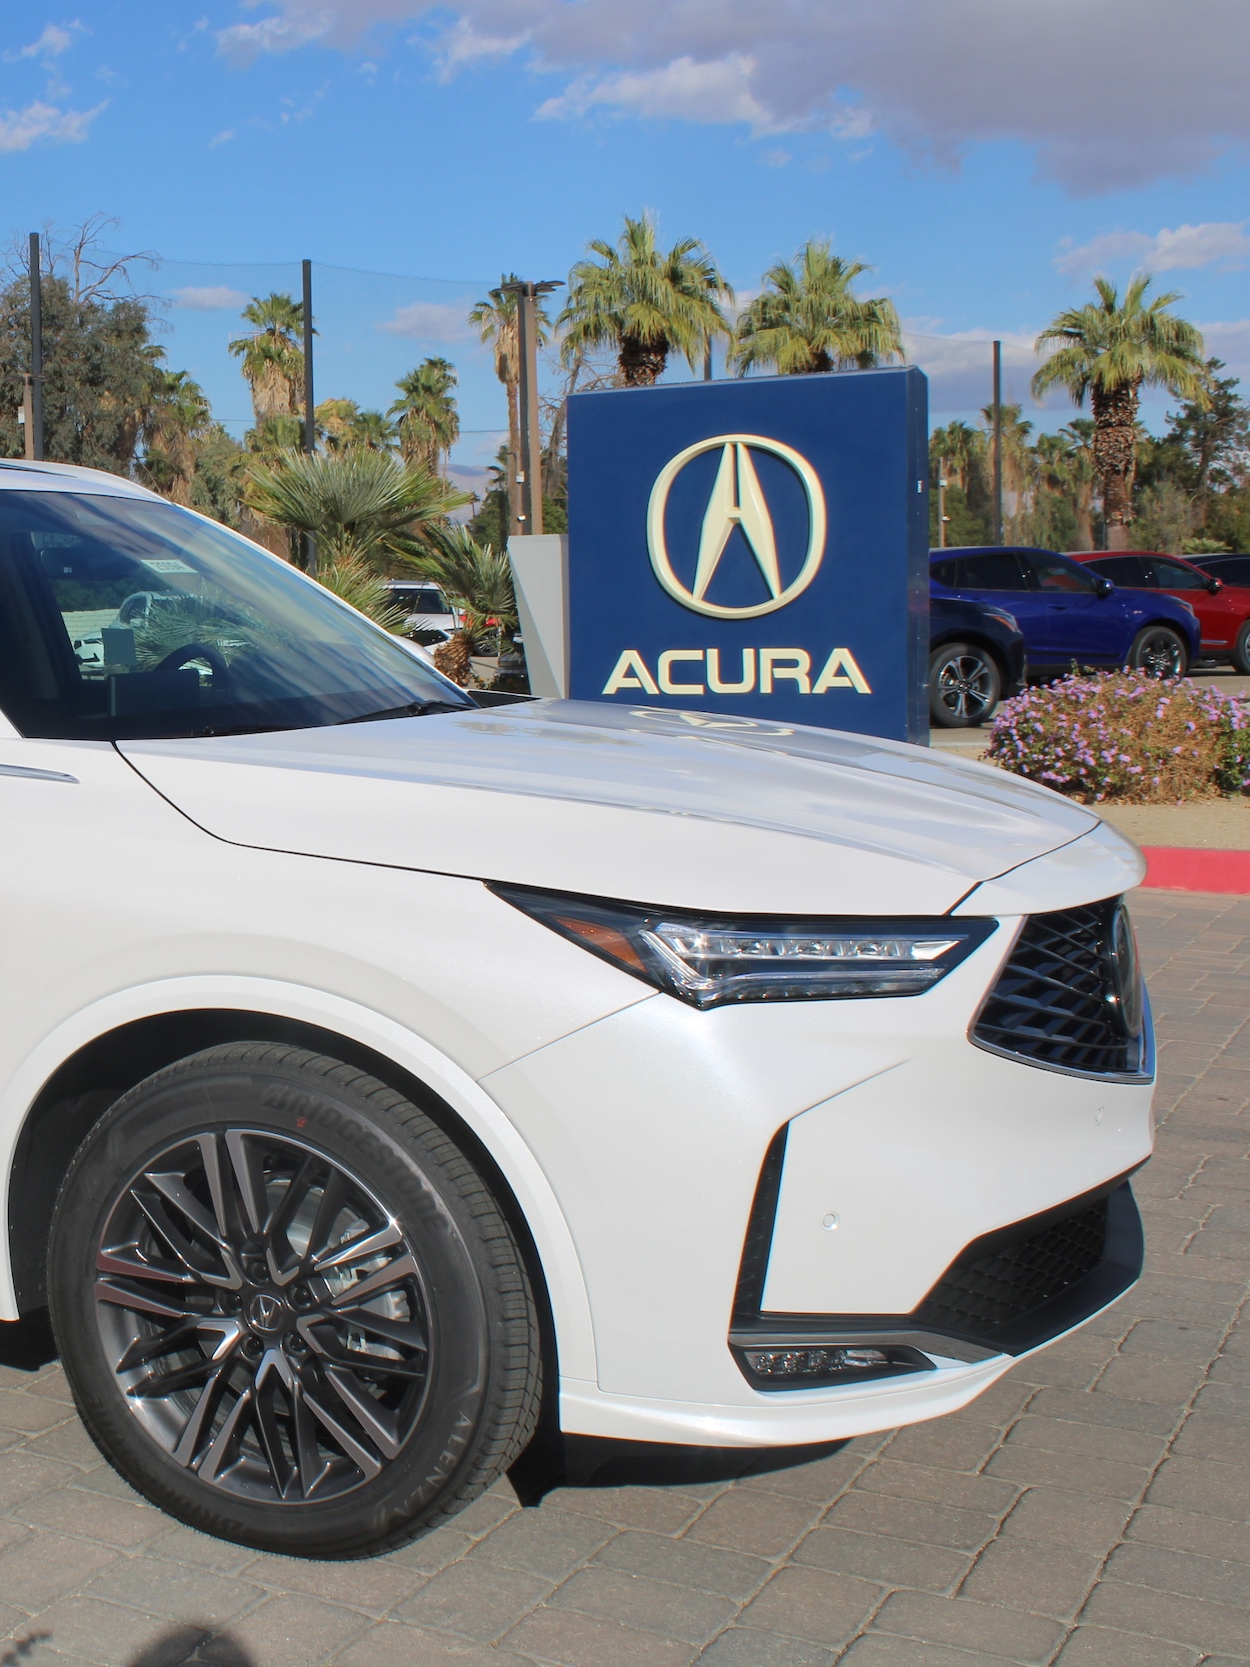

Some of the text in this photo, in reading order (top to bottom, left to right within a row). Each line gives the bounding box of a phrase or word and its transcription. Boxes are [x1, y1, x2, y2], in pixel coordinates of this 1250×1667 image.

[602, 647, 871, 695] ACURA
[261, 1083, 449, 1234] BRIDGESTONE
[393, 1410, 472, 1517] ALENZA
